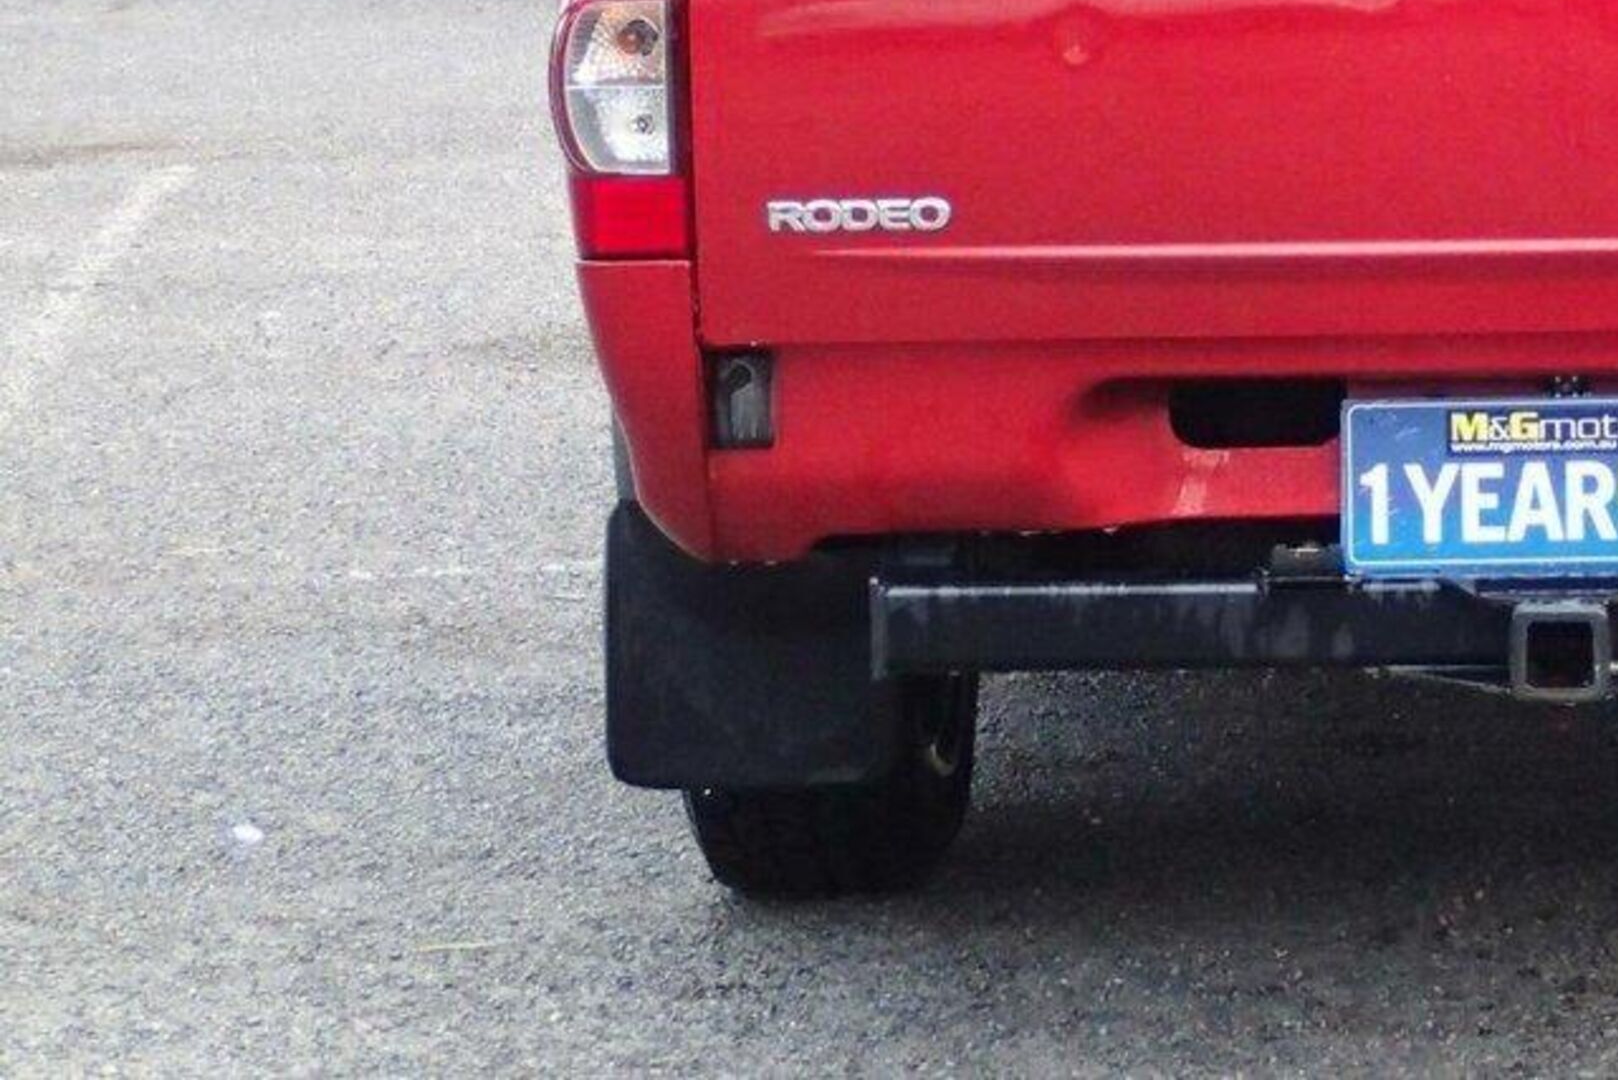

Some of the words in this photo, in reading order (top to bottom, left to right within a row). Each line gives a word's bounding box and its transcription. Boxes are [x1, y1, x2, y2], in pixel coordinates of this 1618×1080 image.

[766, 196, 951, 233] RODEO
[1359, 463, 1391, 546] 1
[1404, 458, 1618, 545] YEAR
